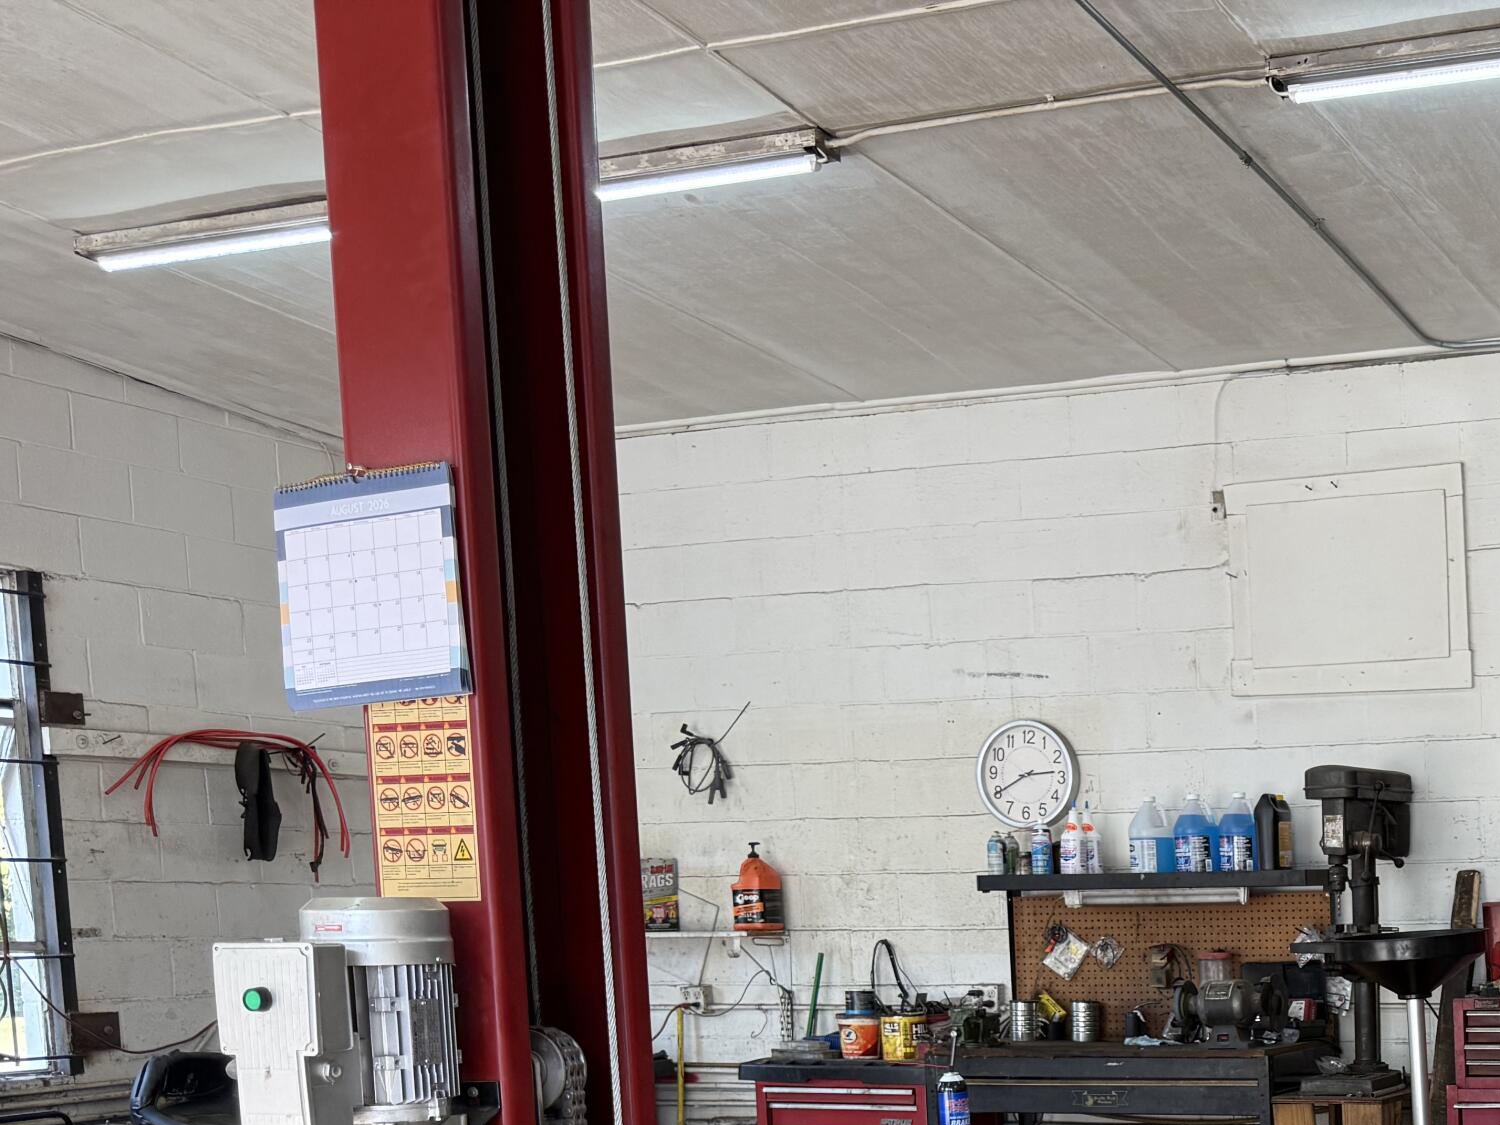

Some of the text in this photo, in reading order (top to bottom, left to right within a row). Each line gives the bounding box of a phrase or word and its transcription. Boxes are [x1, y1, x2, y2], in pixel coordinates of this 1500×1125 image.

[330, 499, 390, 516] AUGUST 2026
[1007, 734, 1015, 749] 11
[1022, 730, 1036, 744] 12
[992, 747, 1005, 762] 10
[1053, 749, 1062, 764] 2
[989, 765, 998, 780] 9
[1057, 770, 1066, 785] 3
[994, 785, 1002, 800] 8
[1051, 789, 1060, 803] 4
[1006, 800, 1014, 815] 7
[1022, 805, 1031, 820] 6
[1038, 802, 1048, 817] 5
[641, 872, 674, 890] RAGS
